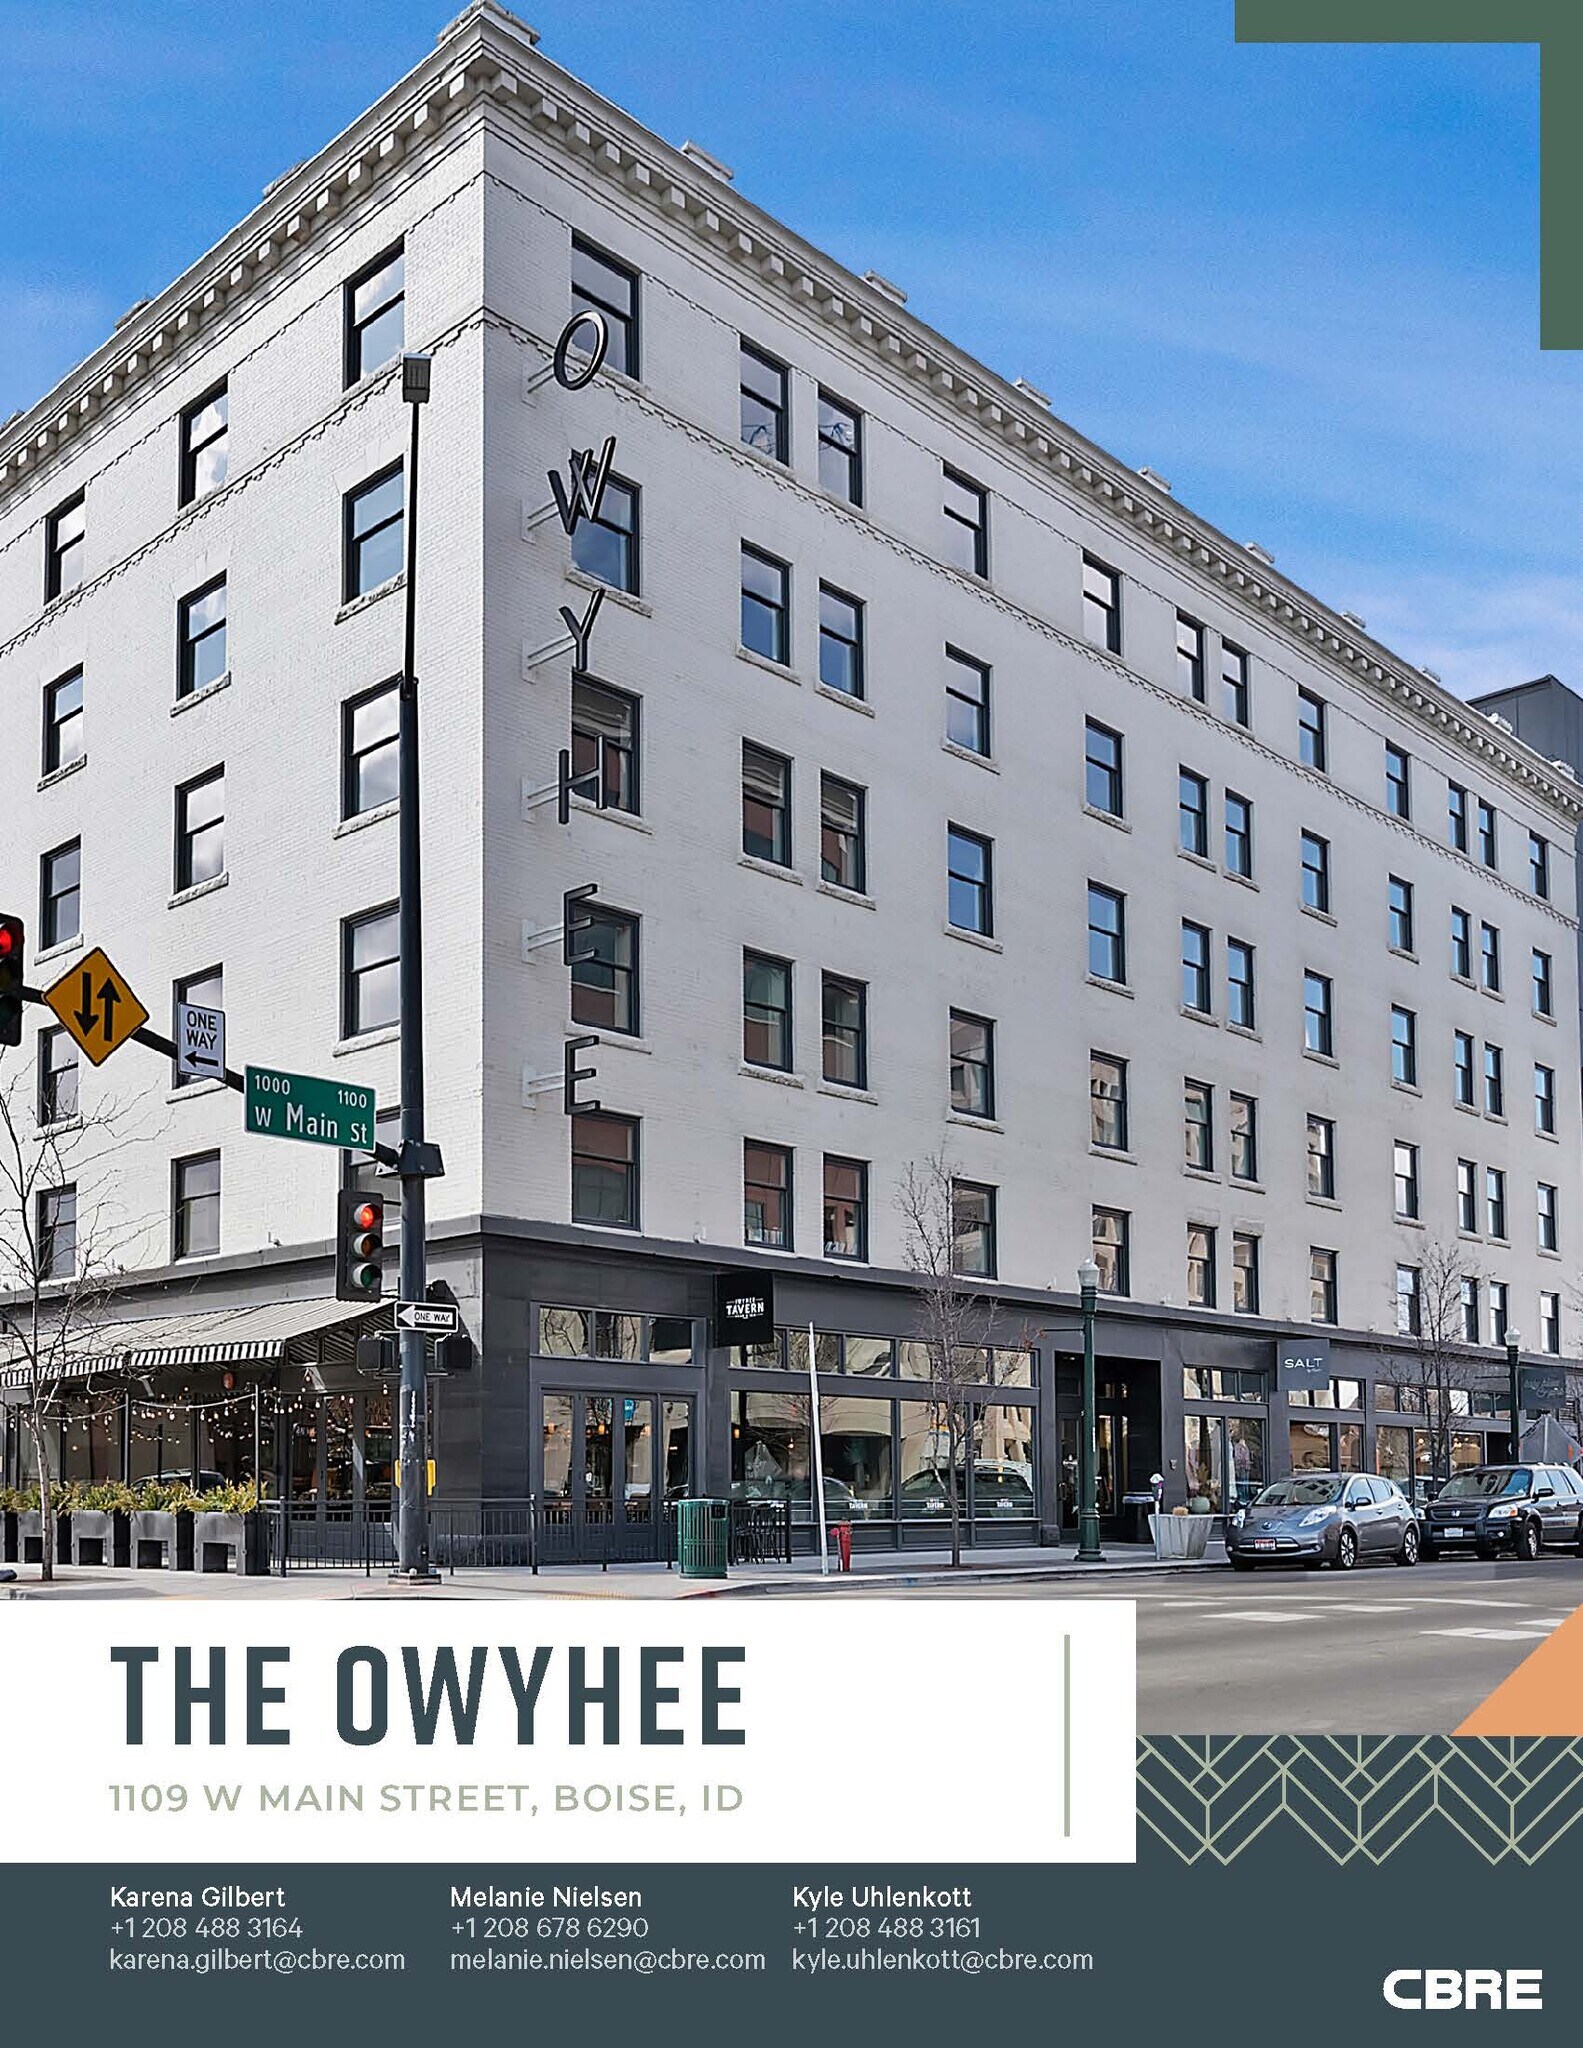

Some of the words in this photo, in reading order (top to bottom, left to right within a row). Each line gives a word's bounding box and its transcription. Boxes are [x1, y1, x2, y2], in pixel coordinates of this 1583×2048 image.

[187, 1010, 217, 1031] ONE
[186, 1029, 217, 1050] WAY
[255, 1075, 291, 1095] 1000
[338, 1090, 367, 1108] 1100
[286, 1102, 338, 1139] Main
[414, 1312, 431, 1321] ONE
[433, 1313, 450, 1322] WAY
[726, 1302, 764, 1316] TAVERN
[1284, 1357, 1323, 1368] SALT
